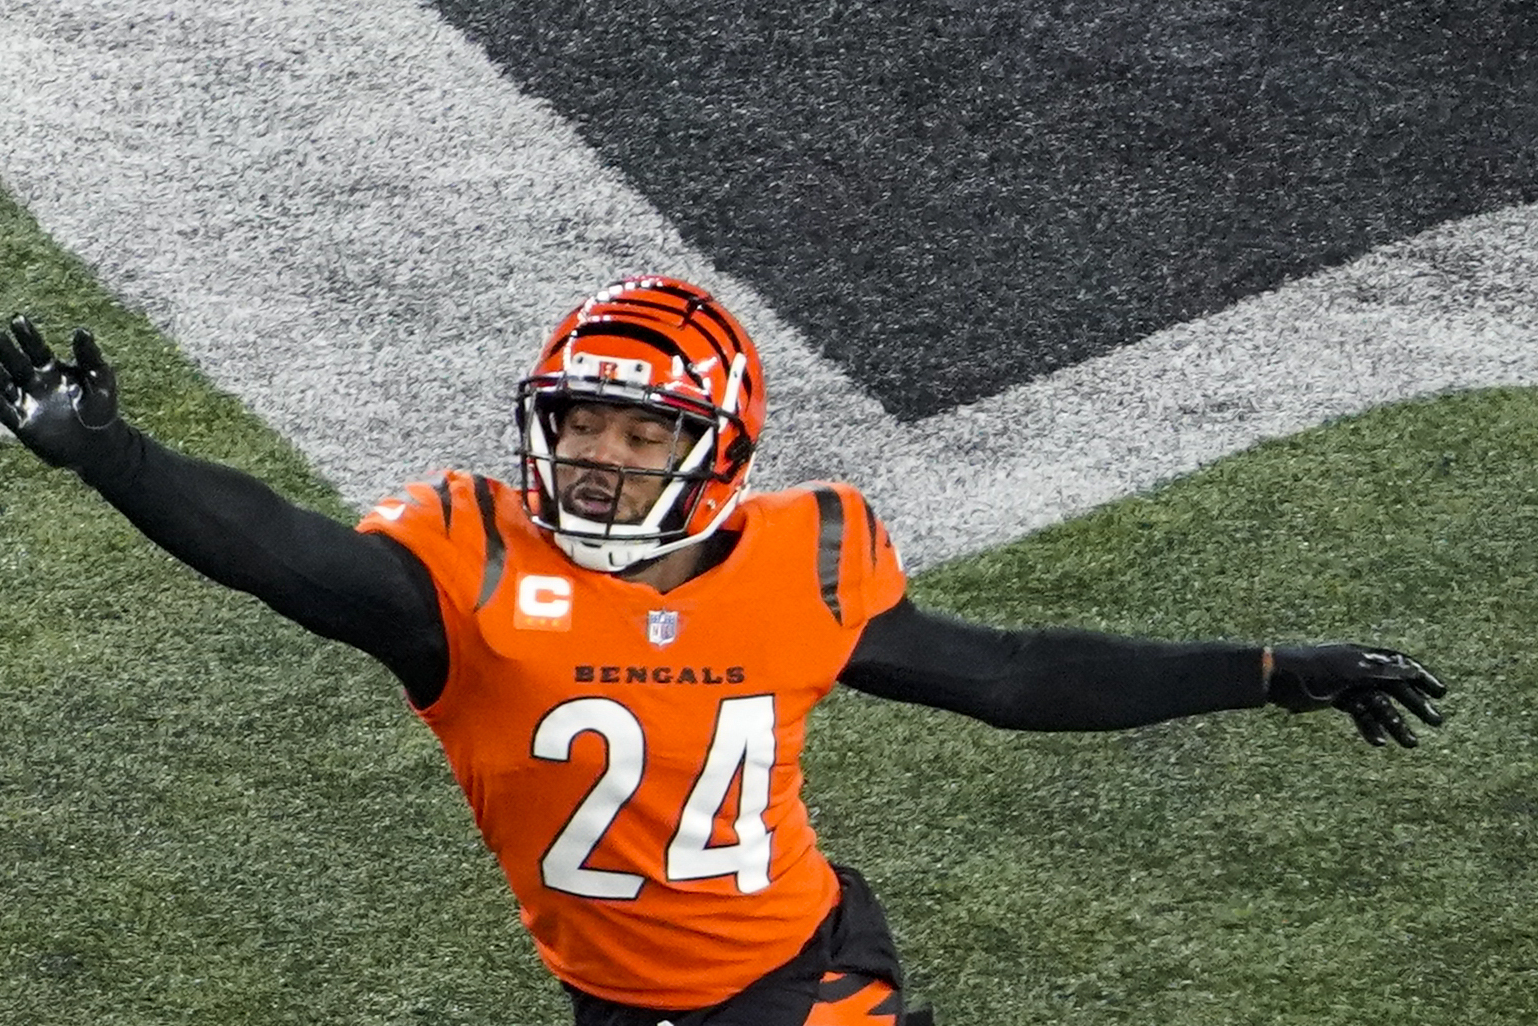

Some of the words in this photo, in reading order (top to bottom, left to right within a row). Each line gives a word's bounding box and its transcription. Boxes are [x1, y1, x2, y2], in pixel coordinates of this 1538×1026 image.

[518, 575, 572, 618] C
[574, 666, 746, 685] BENGALS
[531, 692, 776, 901] 24
